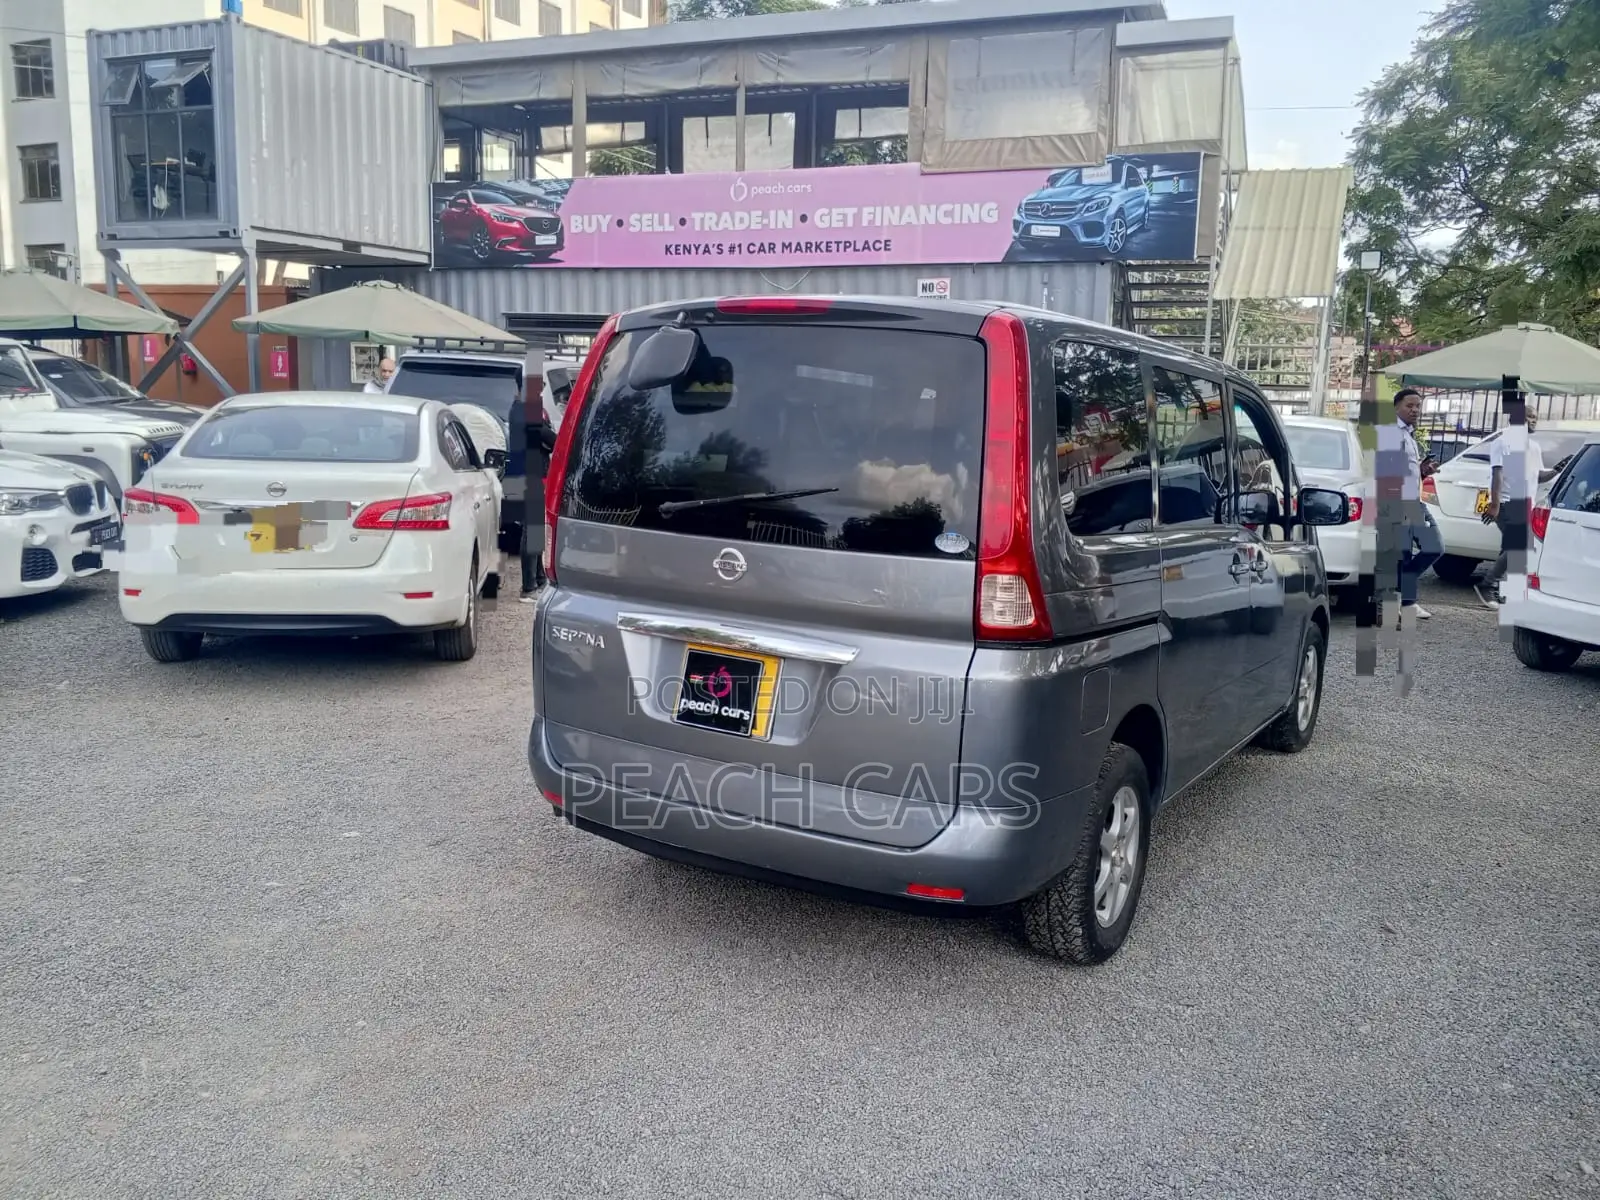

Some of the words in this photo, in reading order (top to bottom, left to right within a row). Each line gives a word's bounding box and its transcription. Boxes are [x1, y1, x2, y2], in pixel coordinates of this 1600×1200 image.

[751, 182, 785, 197] peach
[787, 184, 813, 193] cars
[570, 214, 613, 234] BUY
[628, 212, 675, 233] SELL
[691, 209, 794, 232] TRADE-IN
[814, 207, 858, 229] GET
[861, 202, 999, 227] FINANCING
[664, 243, 724, 256] KENYA'S
[728, 242, 743, 255] #1
[746, 241, 777, 255] CAR
[781, 239, 893, 254] MARKETPLACE
[921, 282, 935, 293] NO
[680, 698, 719, 715] peach
[721, 705, 751, 721] cars
